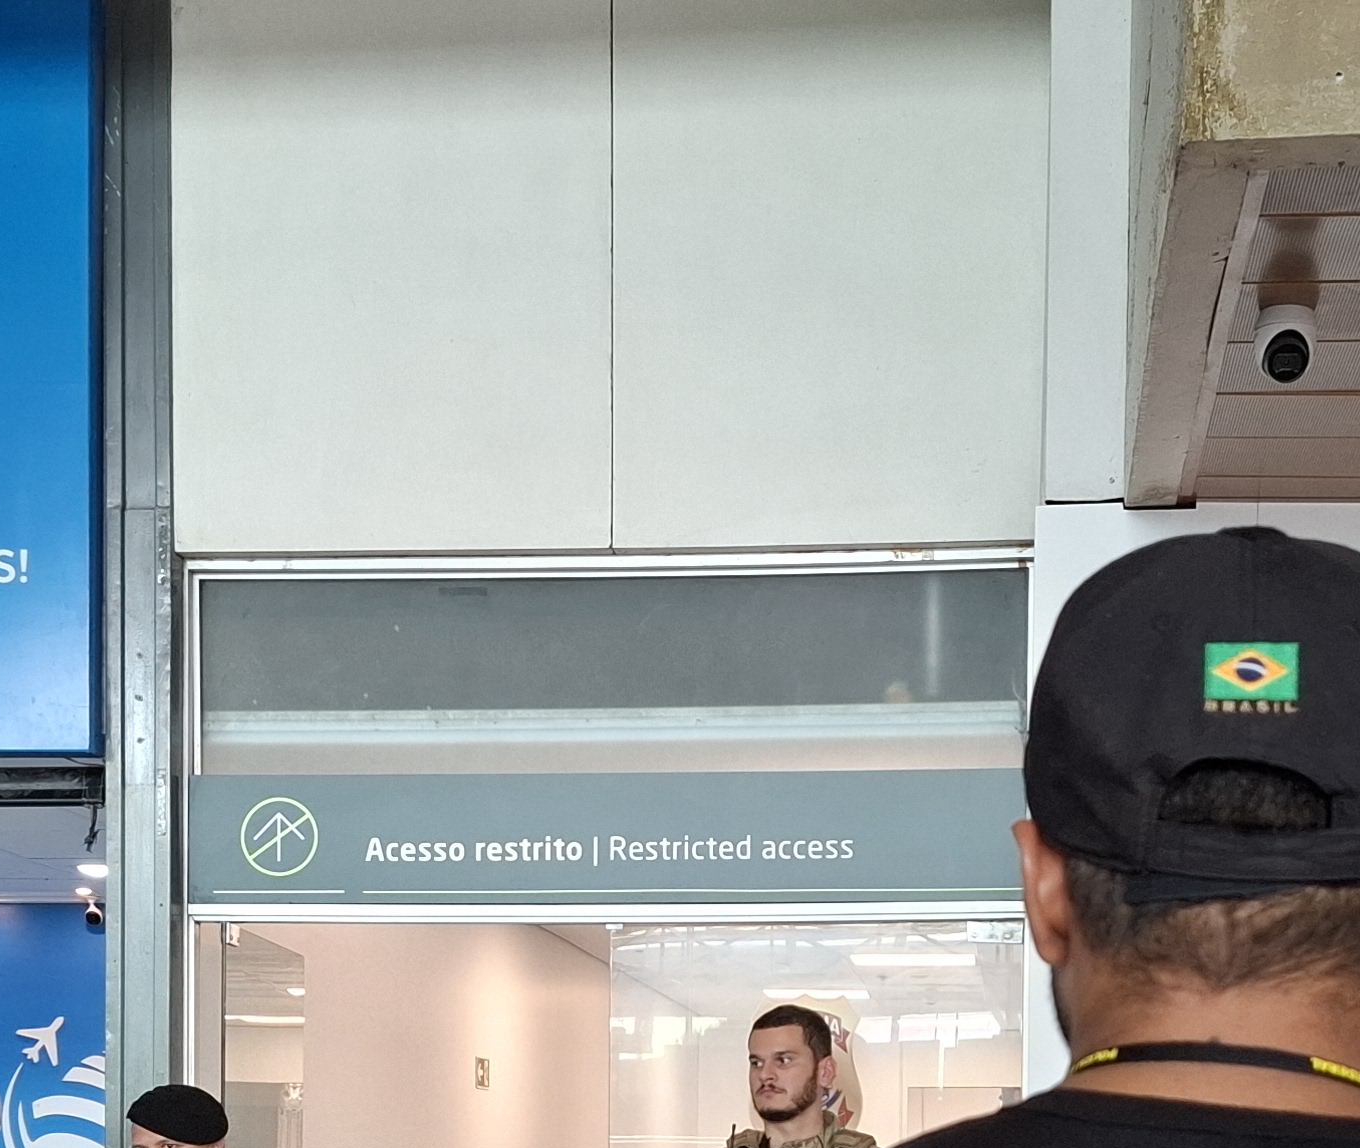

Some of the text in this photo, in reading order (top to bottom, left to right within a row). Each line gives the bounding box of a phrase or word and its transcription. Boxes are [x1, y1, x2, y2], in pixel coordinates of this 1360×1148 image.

[1203, 700, 1299, 713] BRASIL
[365, 836, 466, 864] Acesso
[475, 835, 584, 863] restrito
[608, 835, 753, 862] Restricted
[761, 838, 854, 860] access
